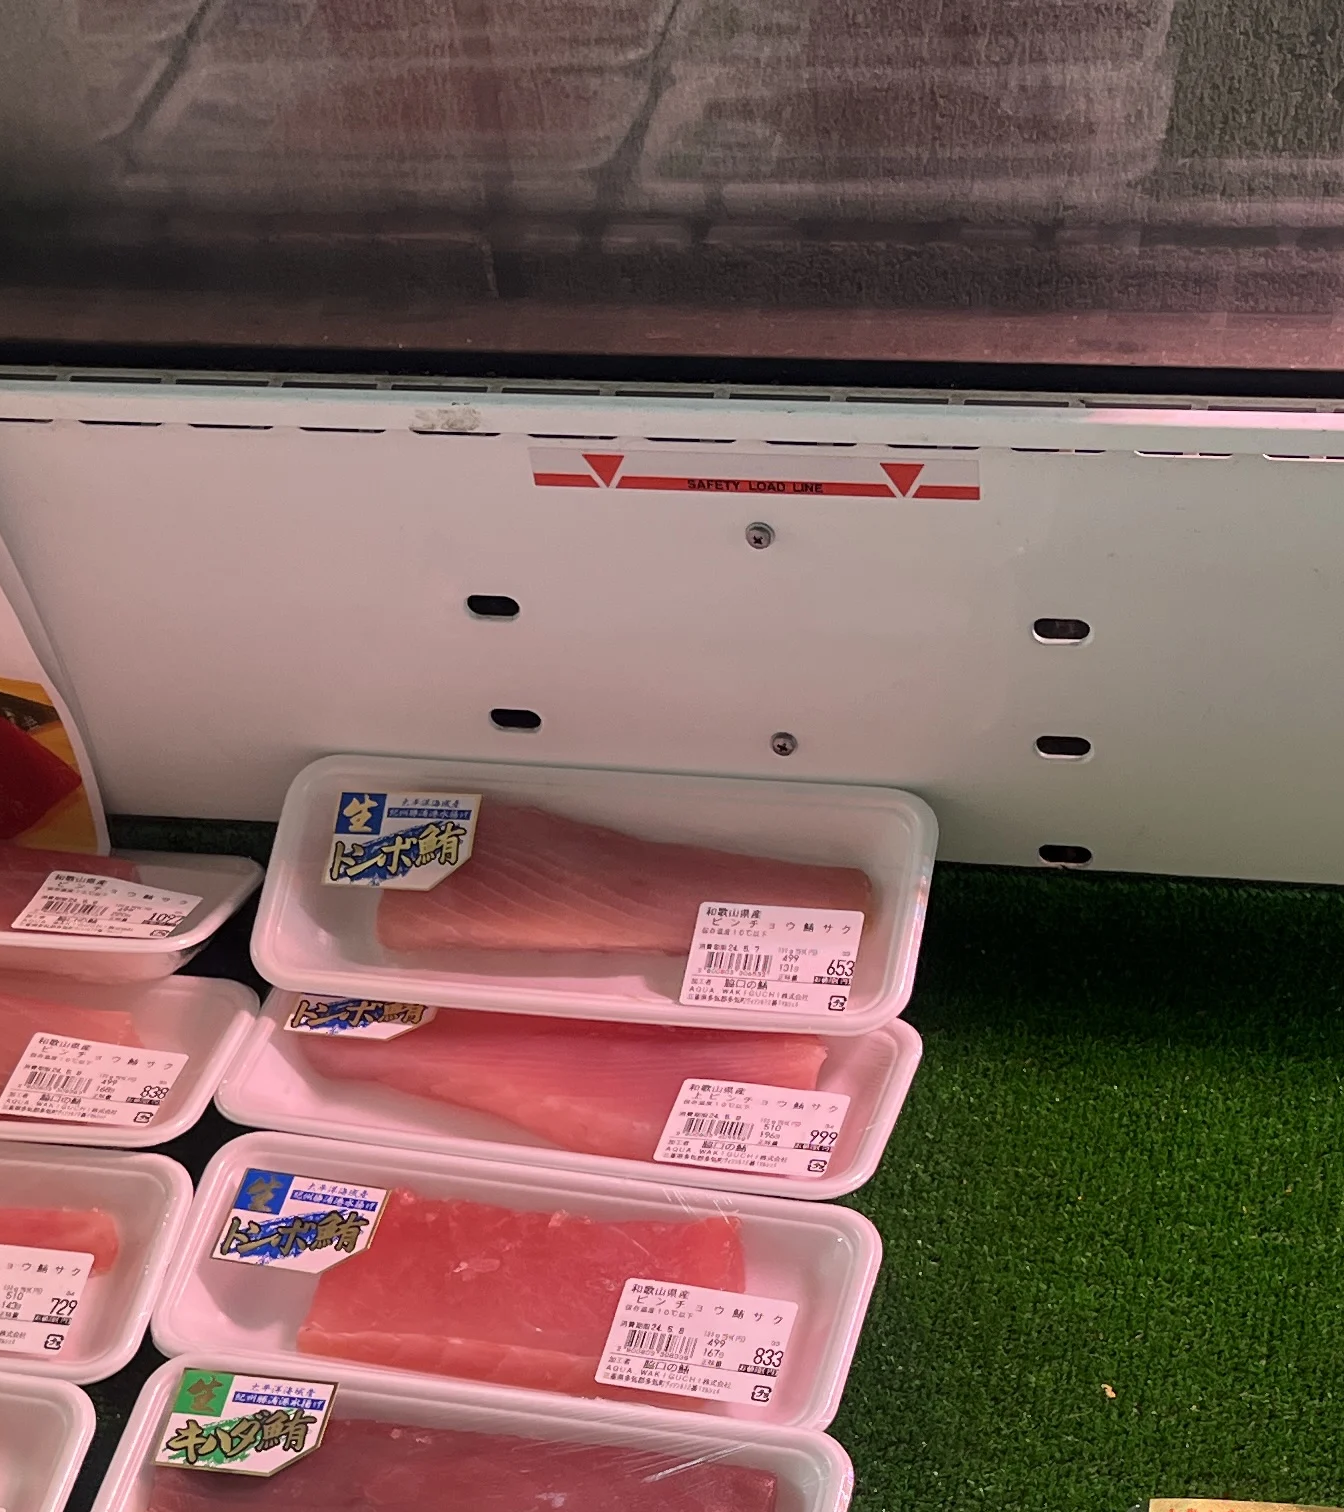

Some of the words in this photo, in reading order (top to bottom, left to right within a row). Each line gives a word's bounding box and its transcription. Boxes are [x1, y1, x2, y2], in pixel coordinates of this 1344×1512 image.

[687, 479, 741, 491] SAFETY
[749, 481, 786, 493] LOAD
[793, 482, 824, 494] LINE
[343, 797, 377, 832] 生
[327, 820, 466, 879] トンボ鮪
[705, 906, 761, 919] 和歌山県産
[825, 959, 855, 977] 653
[138, 1085, 170, 1099] 838
[689, 1082, 746, 1095] 和歌山県産
[807, 1129, 838, 1145] 999
[246, 1174, 282, 1213] 生
[217, 1210, 369, 1254] トンボ鮪
[630, 1282, 690, 1300] 和歌山県産
[47, 1297, 78, 1317] 729
[751, 1347, 784, 1368] 833
[187, 1375, 222, 1412] 生
[165, 1408, 317, 1464] キハダ鮪
